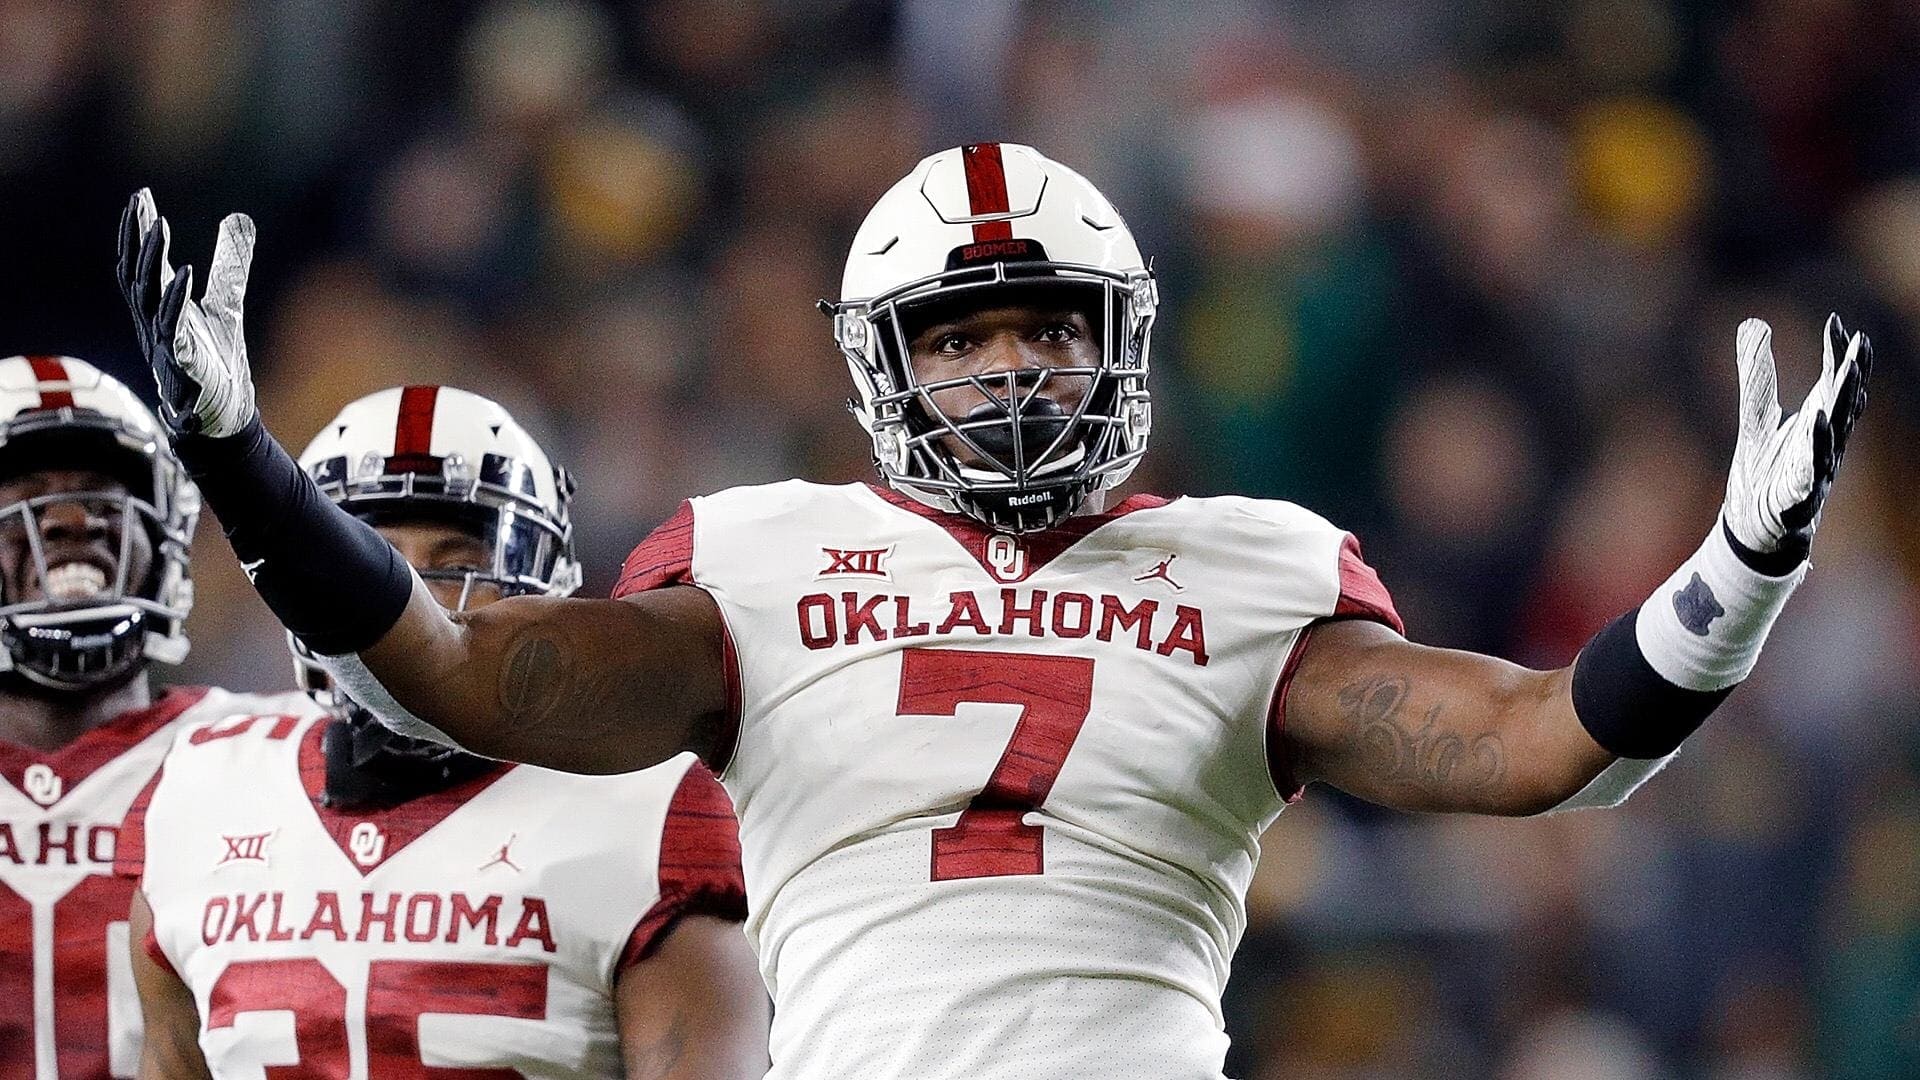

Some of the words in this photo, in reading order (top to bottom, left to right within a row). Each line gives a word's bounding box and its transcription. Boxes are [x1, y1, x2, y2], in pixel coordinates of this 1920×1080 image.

[963, 241, 1027, 260] BOOMER
[820, 546, 890, 577] XII
[987, 535, 1024, 580] OU
[797, 588, 1210, 667] OKLAHOMA
[896, 647, 1096, 882] 7
[217, 832, 272, 865] XII
[201, 891, 558, 954] OKLAHOMA
